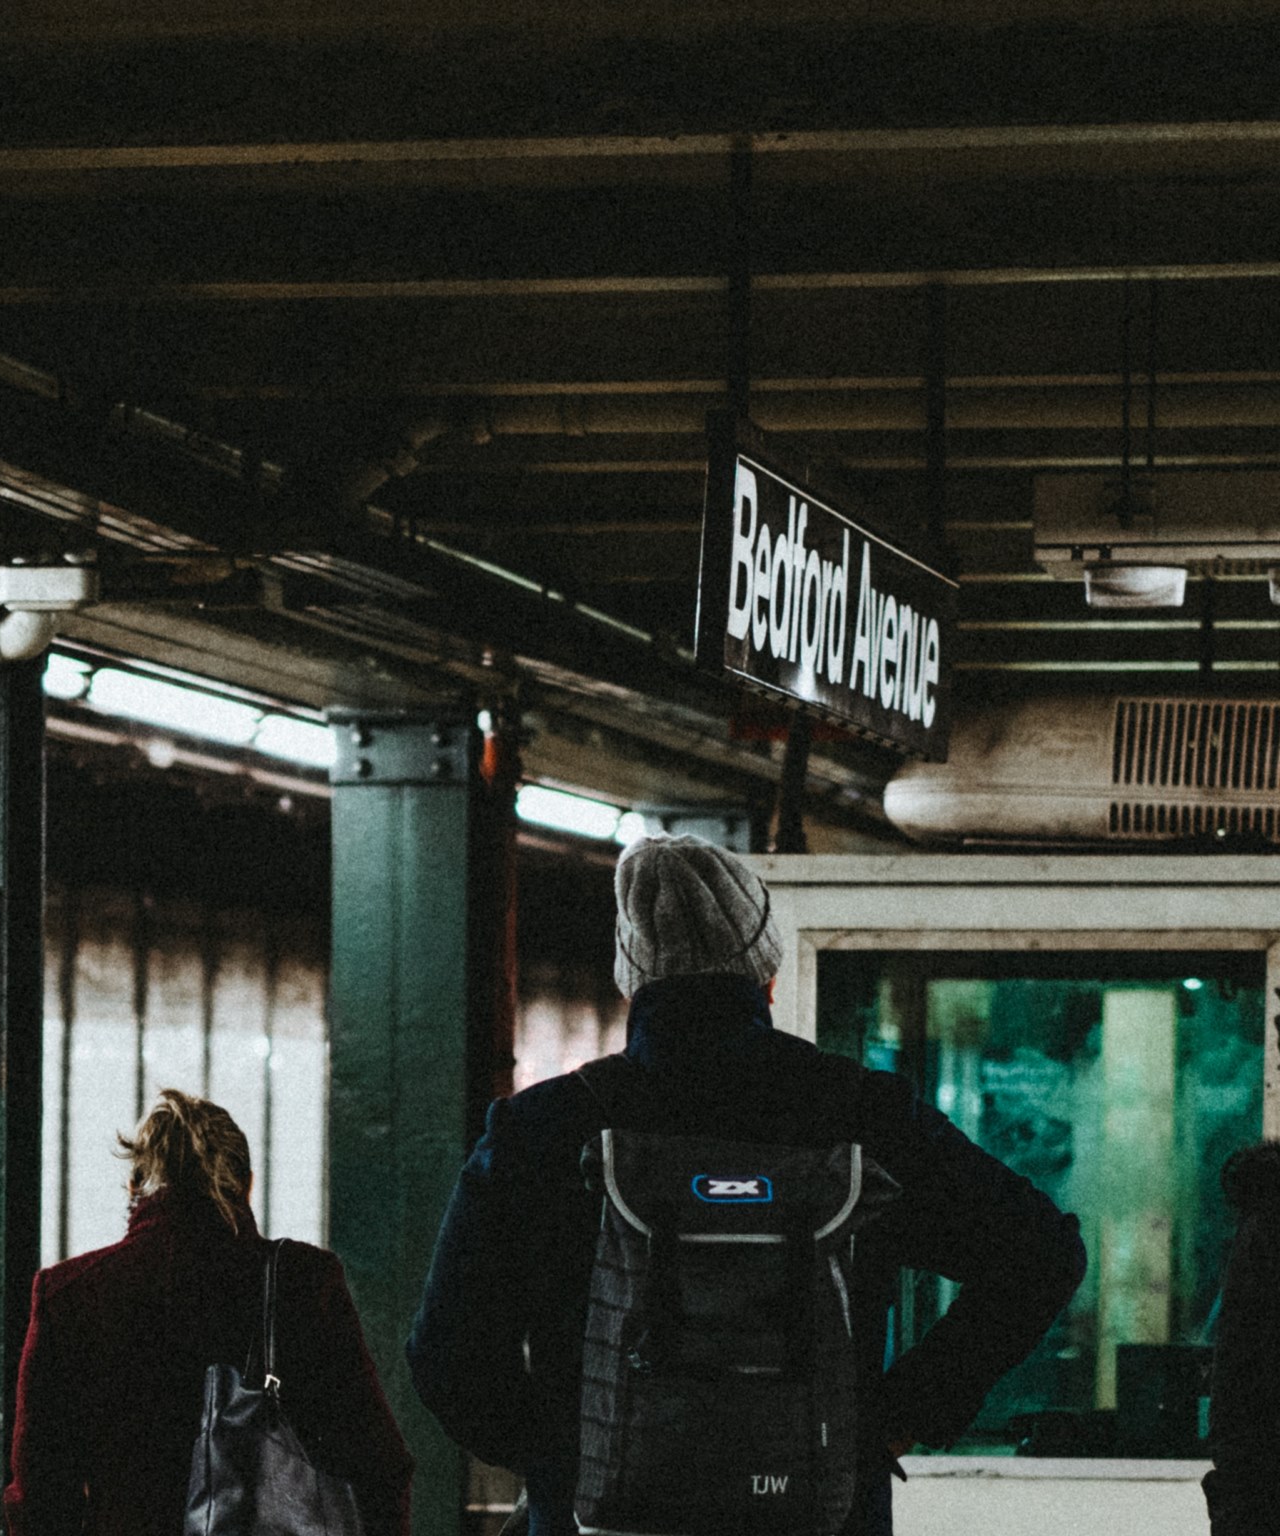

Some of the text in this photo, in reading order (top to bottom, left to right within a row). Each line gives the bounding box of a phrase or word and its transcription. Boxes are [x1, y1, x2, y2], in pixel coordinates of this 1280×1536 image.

[727, 463, 939, 729] Bedford Avenue
[750, 1475, 789, 1495] TJW
